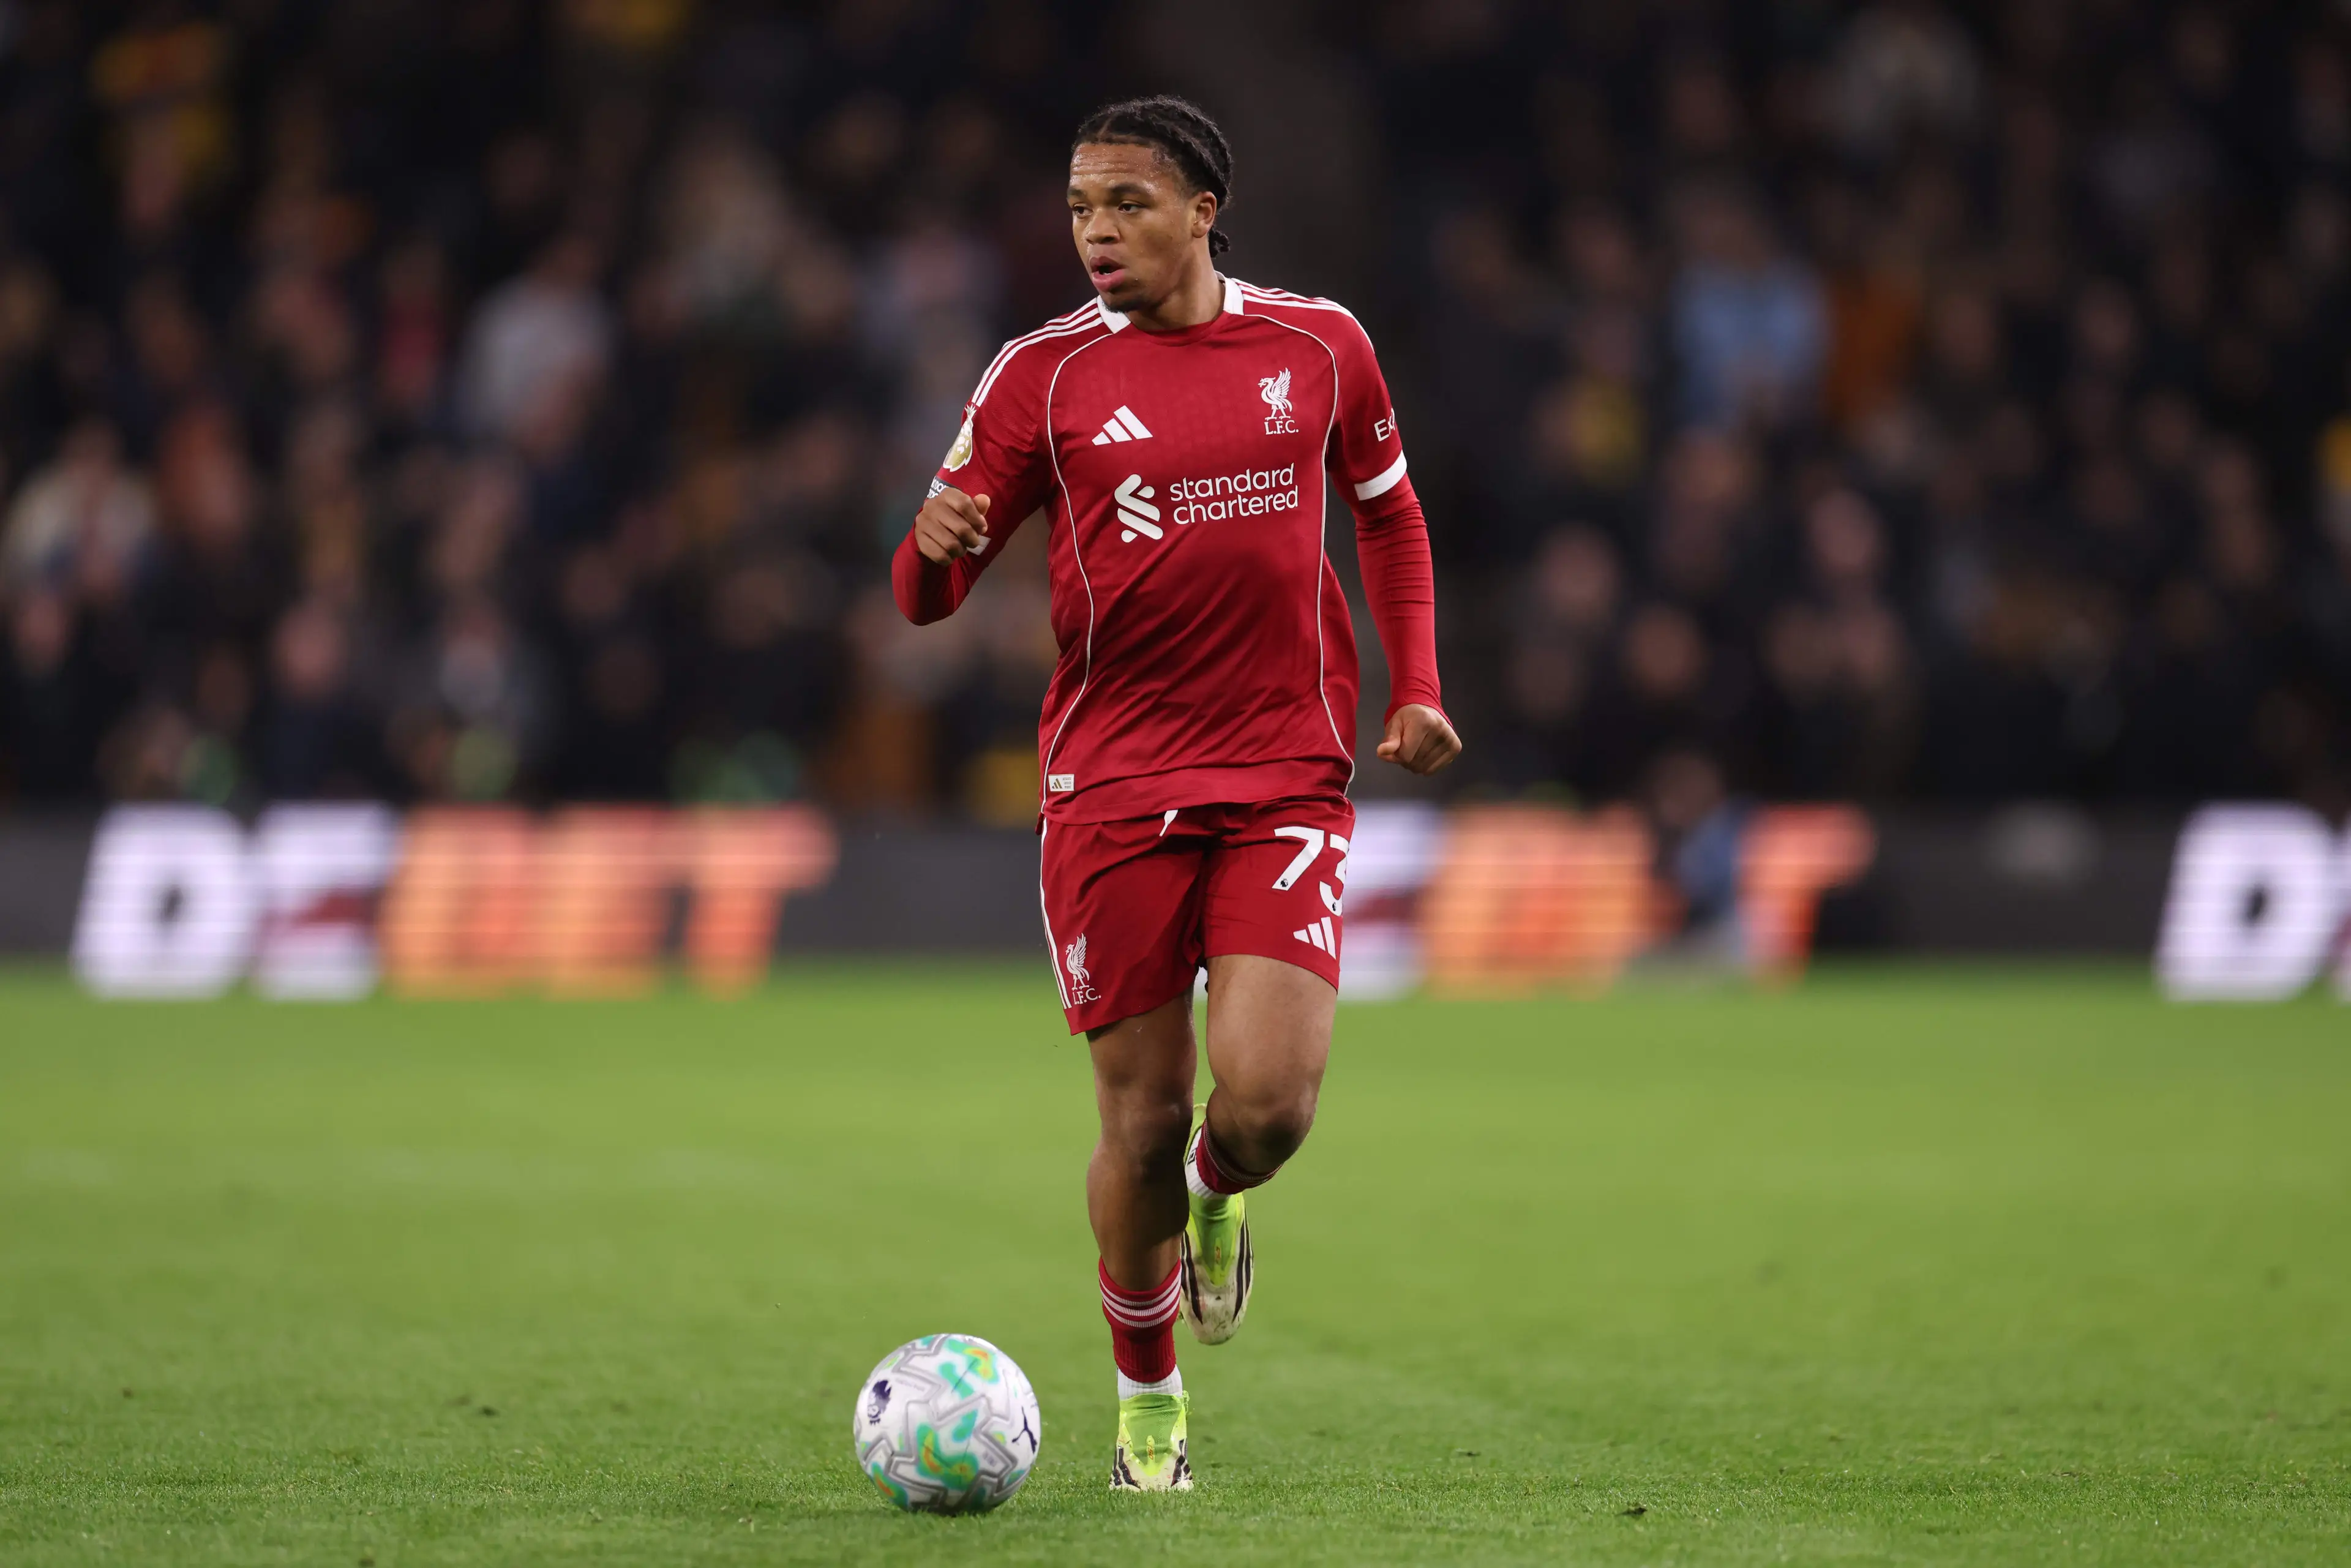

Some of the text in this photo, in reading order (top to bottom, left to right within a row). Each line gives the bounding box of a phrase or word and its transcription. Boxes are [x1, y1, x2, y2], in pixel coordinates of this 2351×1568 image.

[1264, 419, 1299, 435] L.F.C.
[1170, 462, 1294, 501] standard
[1173, 485, 1298, 525] chartered
[1272, 826, 1349, 917] 73
[1072, 988, 1101, 1005] L.F.C.
